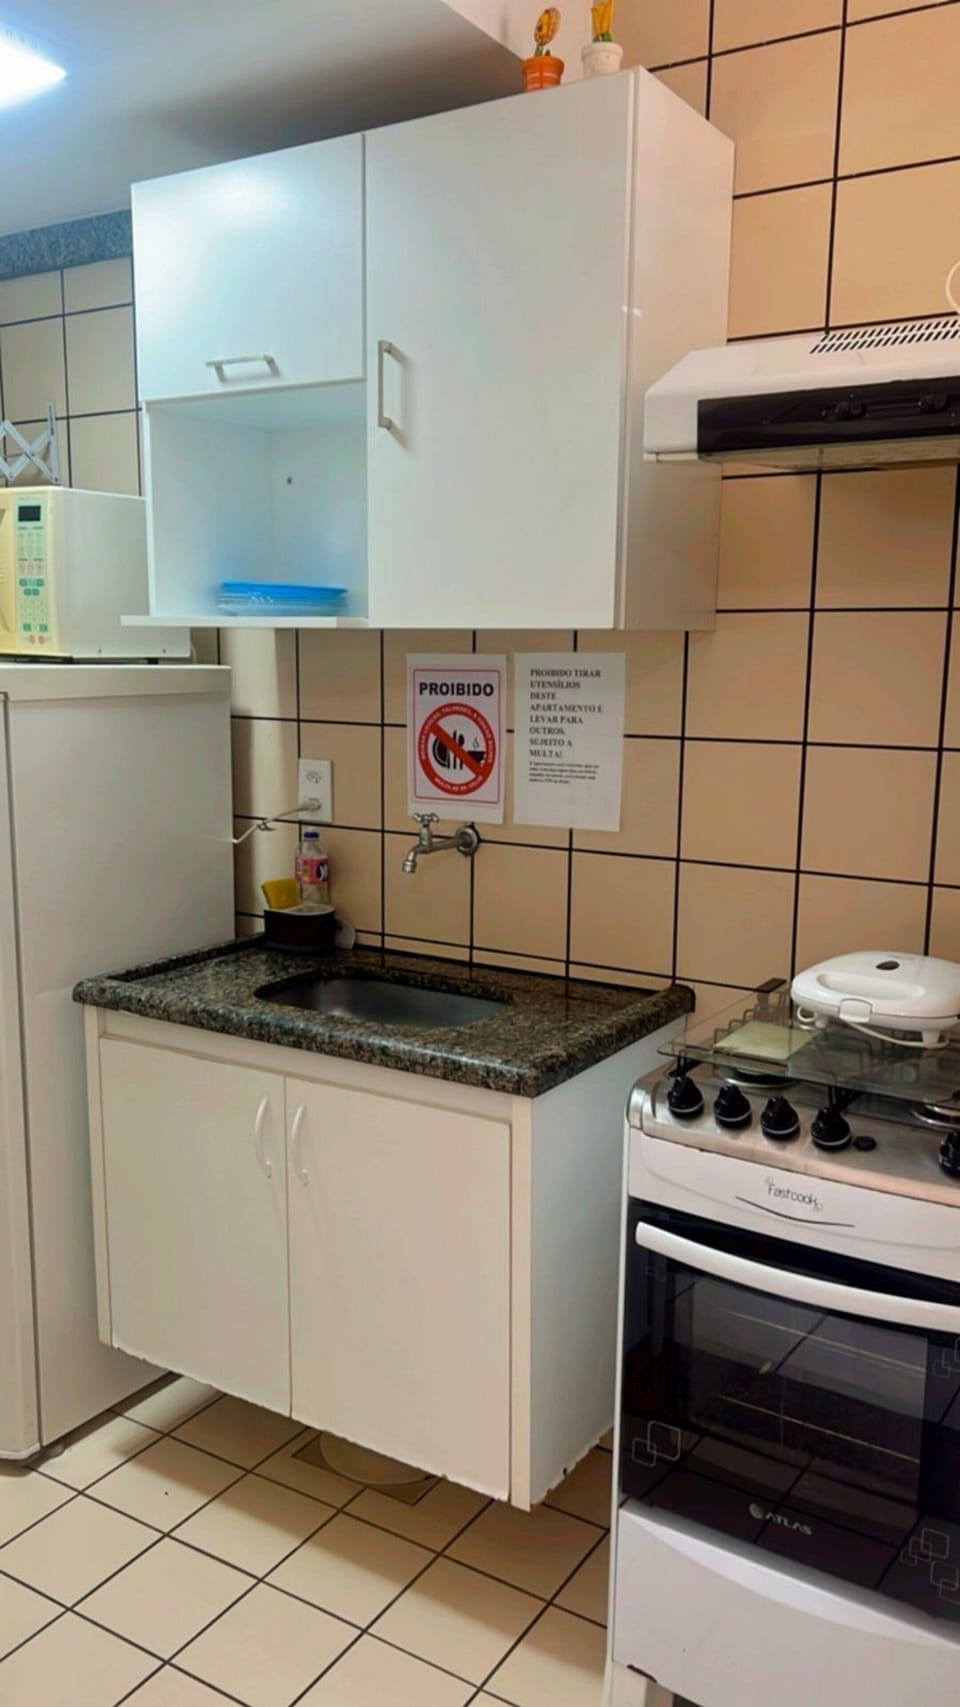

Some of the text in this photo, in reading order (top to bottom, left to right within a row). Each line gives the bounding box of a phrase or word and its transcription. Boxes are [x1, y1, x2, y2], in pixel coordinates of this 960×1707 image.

[530, 668, 602, 678] PROIBIDO TIRAR
[530, 679, 581, 689] UTENSÍLIOS
[419, 682, 495, 697] PROIBIDO
[530, 691, 556, 700] DESTE
[530, 703, 603, 713] APARTAMENTO E
[529, 715, 584, 724] LEVAR PARA
[529, 738, 573, 748] SUJEITO A
[529, 749, 562, 759] MULTA!
[767, 1183, 818, 1208] Fastcook
[765, 1511, 813, 1536] ATLAS
